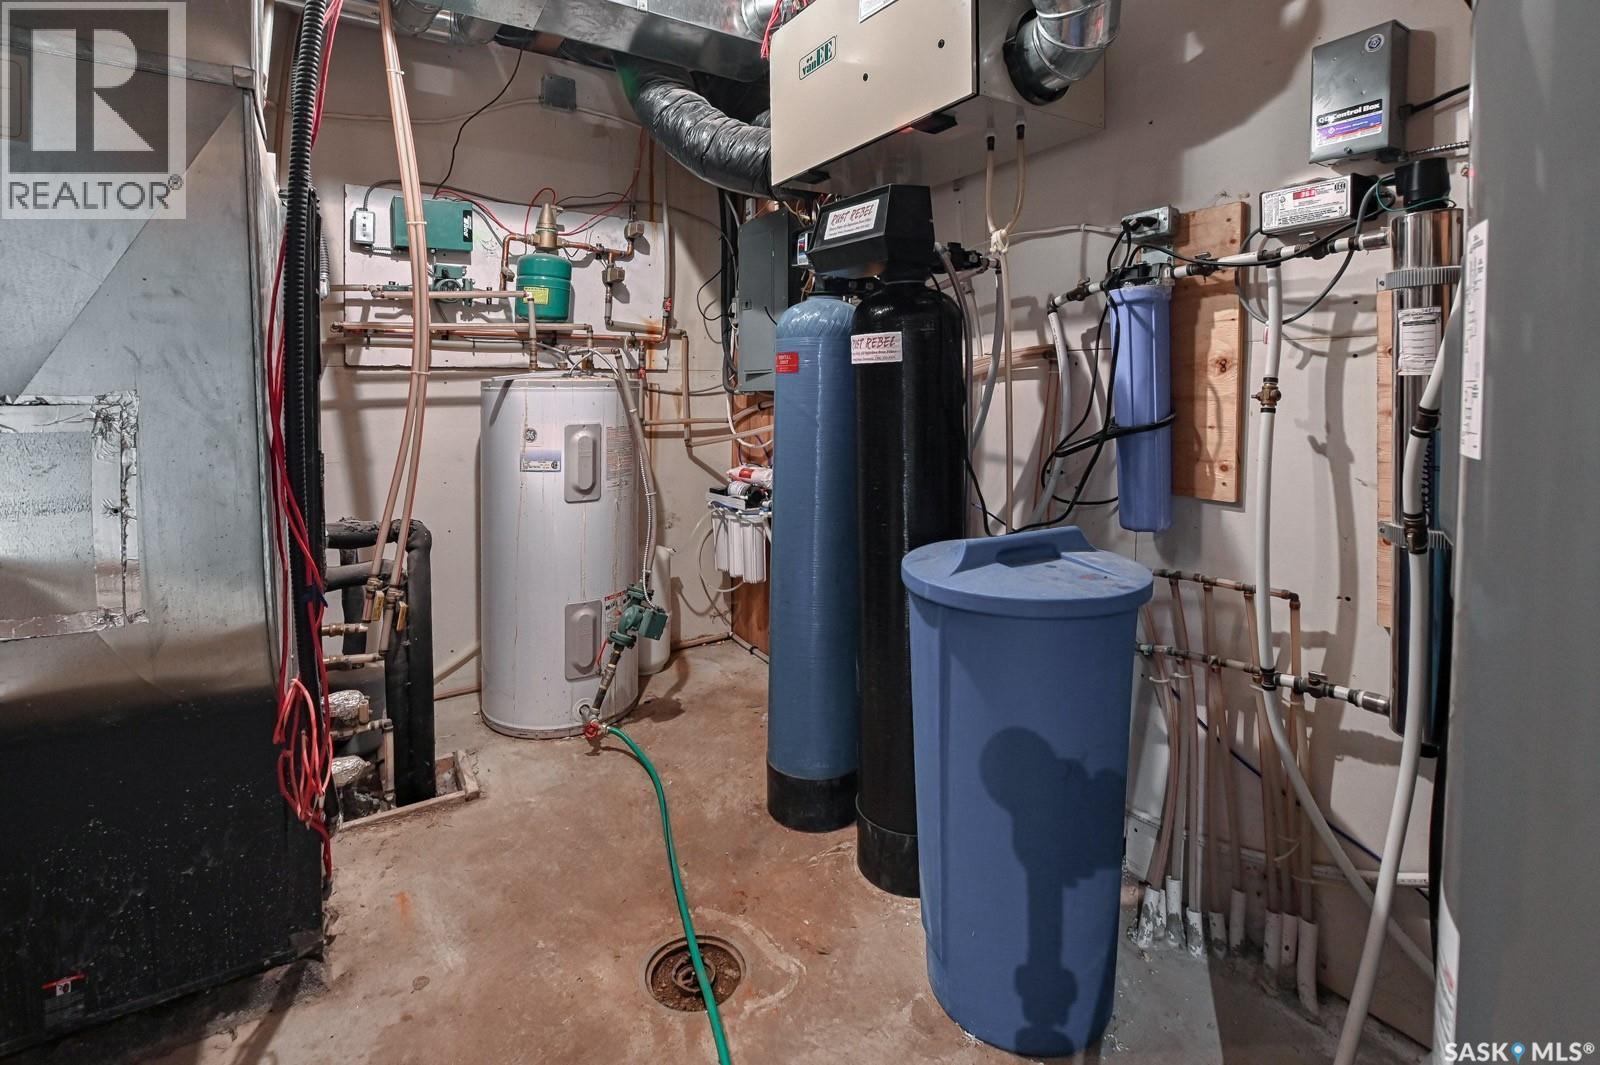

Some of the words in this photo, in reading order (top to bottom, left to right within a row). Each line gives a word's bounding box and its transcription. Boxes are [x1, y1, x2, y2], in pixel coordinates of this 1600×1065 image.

[1363, 103, 1381, 112] Box
[850, 203, 875, 222] REBEL
[865, 335, 896, 350] REBEL
